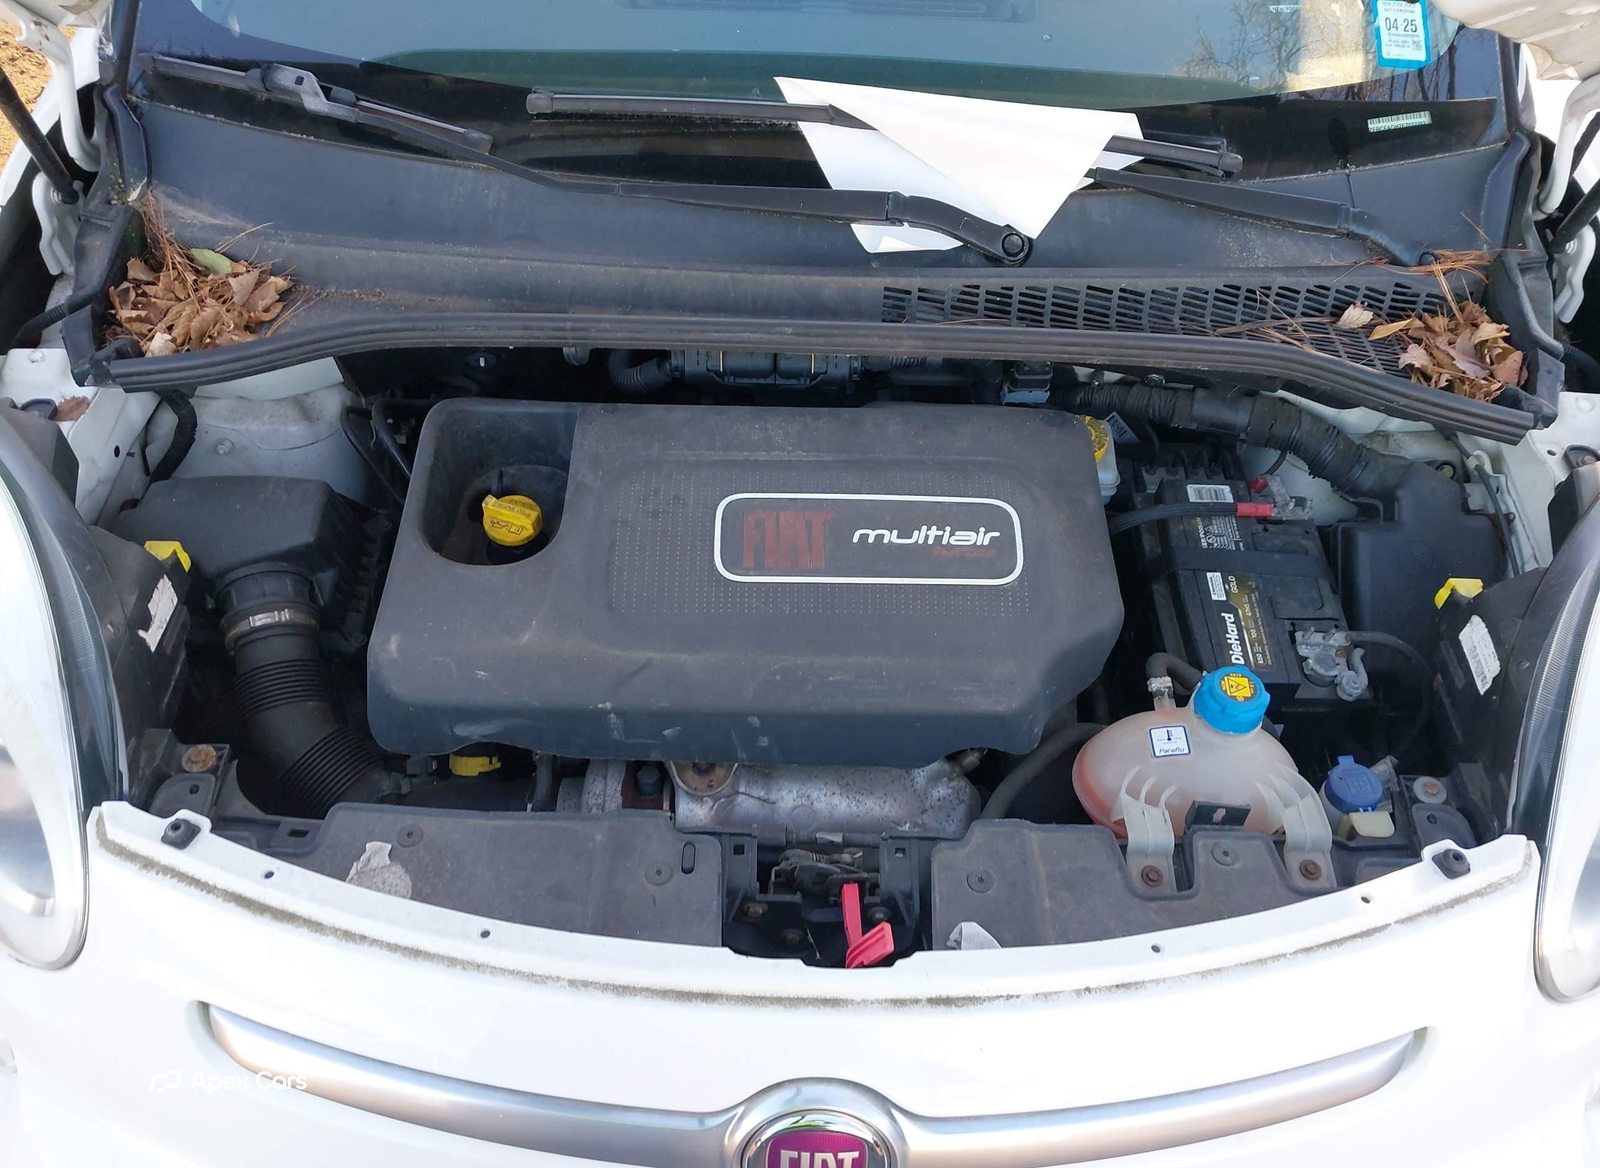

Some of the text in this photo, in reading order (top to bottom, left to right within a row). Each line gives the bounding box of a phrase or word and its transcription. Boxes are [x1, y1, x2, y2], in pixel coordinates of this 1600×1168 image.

[742, 510, 834, 569] FIAT
[852, 525, 1000, 547] multiair
[1227, 575, 1239, 594] GOLD
[1221, 612, 1245, 665] DieHard
[1158, 746, 1186, 755] Paraflu
